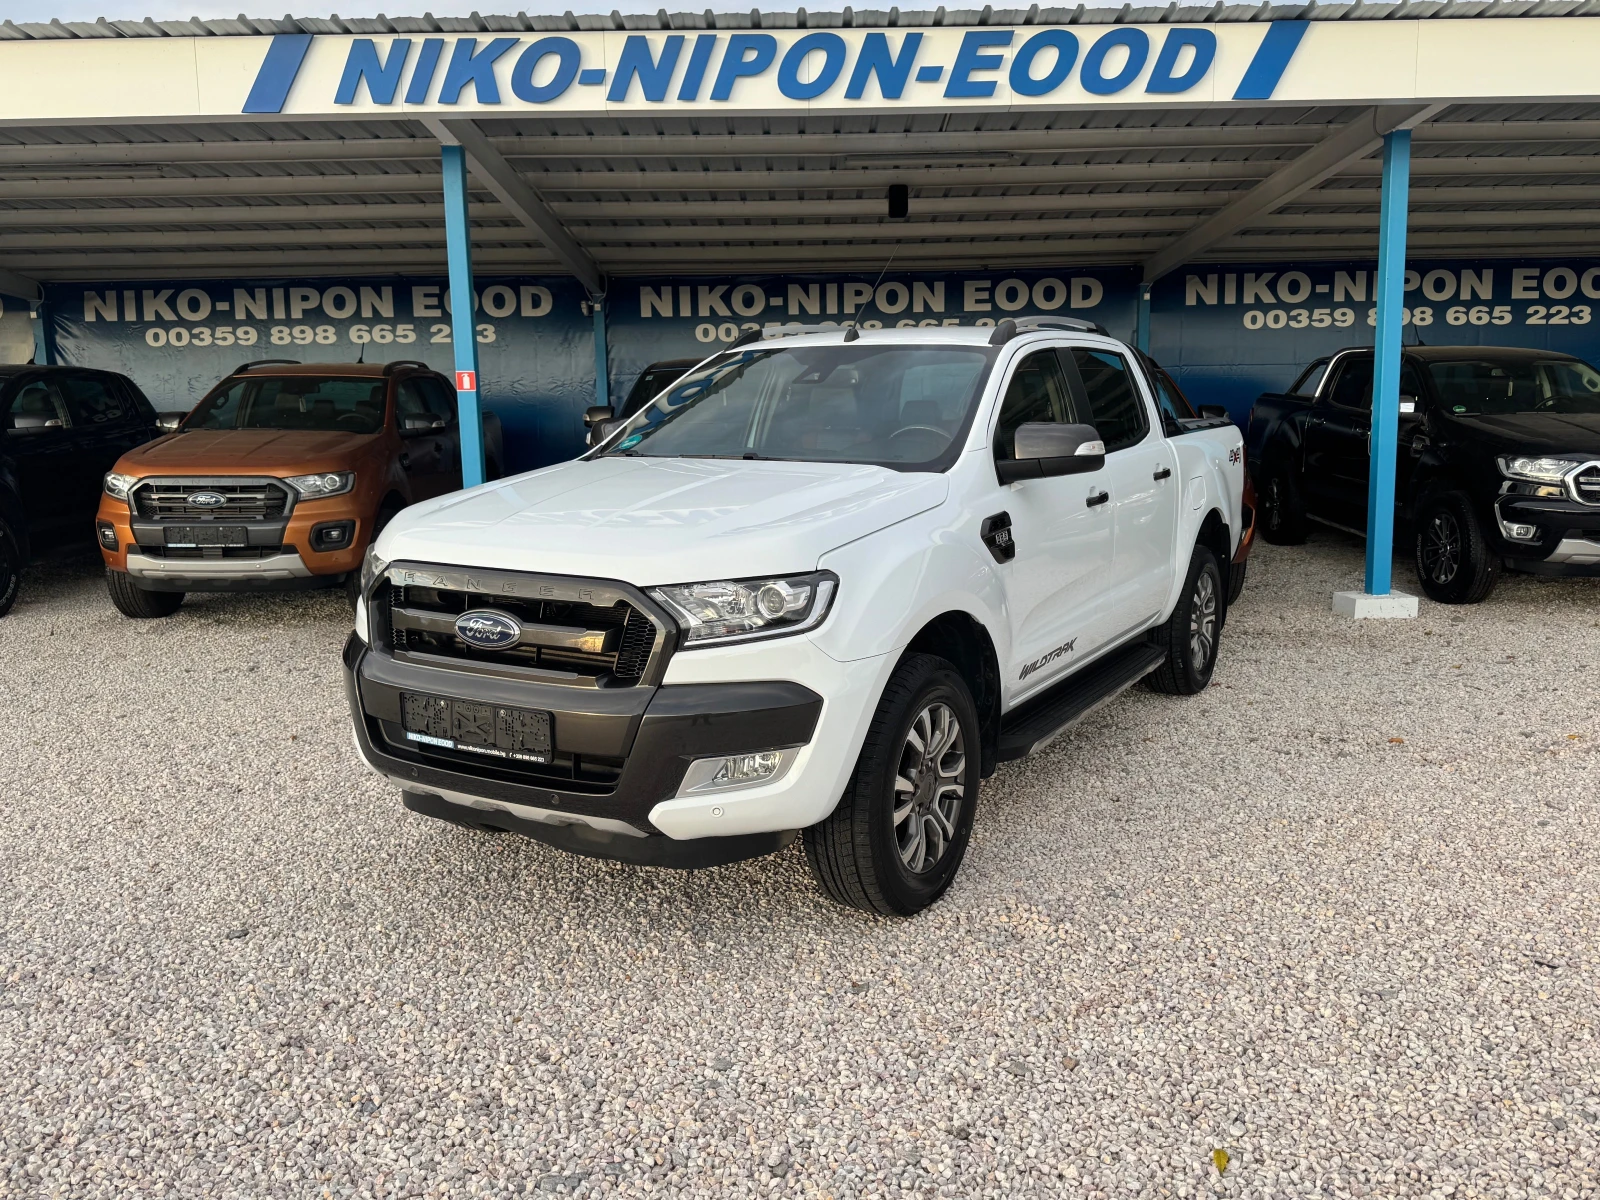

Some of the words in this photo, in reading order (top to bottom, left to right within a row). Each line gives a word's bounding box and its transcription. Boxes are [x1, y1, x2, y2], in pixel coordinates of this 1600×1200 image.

[336, 27, 1217, 103] NIKO-NIPON-EOOD
[83, 286, 395, 322] NIKO-NIPON
[640, 280, 945, 318] NIKO-NIPON
[963, 277, 1104, 312] EOOD
[1243, 308, 1356, 331] 00359
[1445, 305, 1513, 327] 665
[1525, 305, 1592, 326] 223
[144, 326, 259, 348] 00359
[270, 325, 337, 346] 898
[348, 324, 417, 345] 665
[430, 323, 497, 345] 23
[403, 571, 596, 599] RANGER
[466, 618, 501, 640] Ford
[1018, 636, 1078, 681] WILDTRAK
